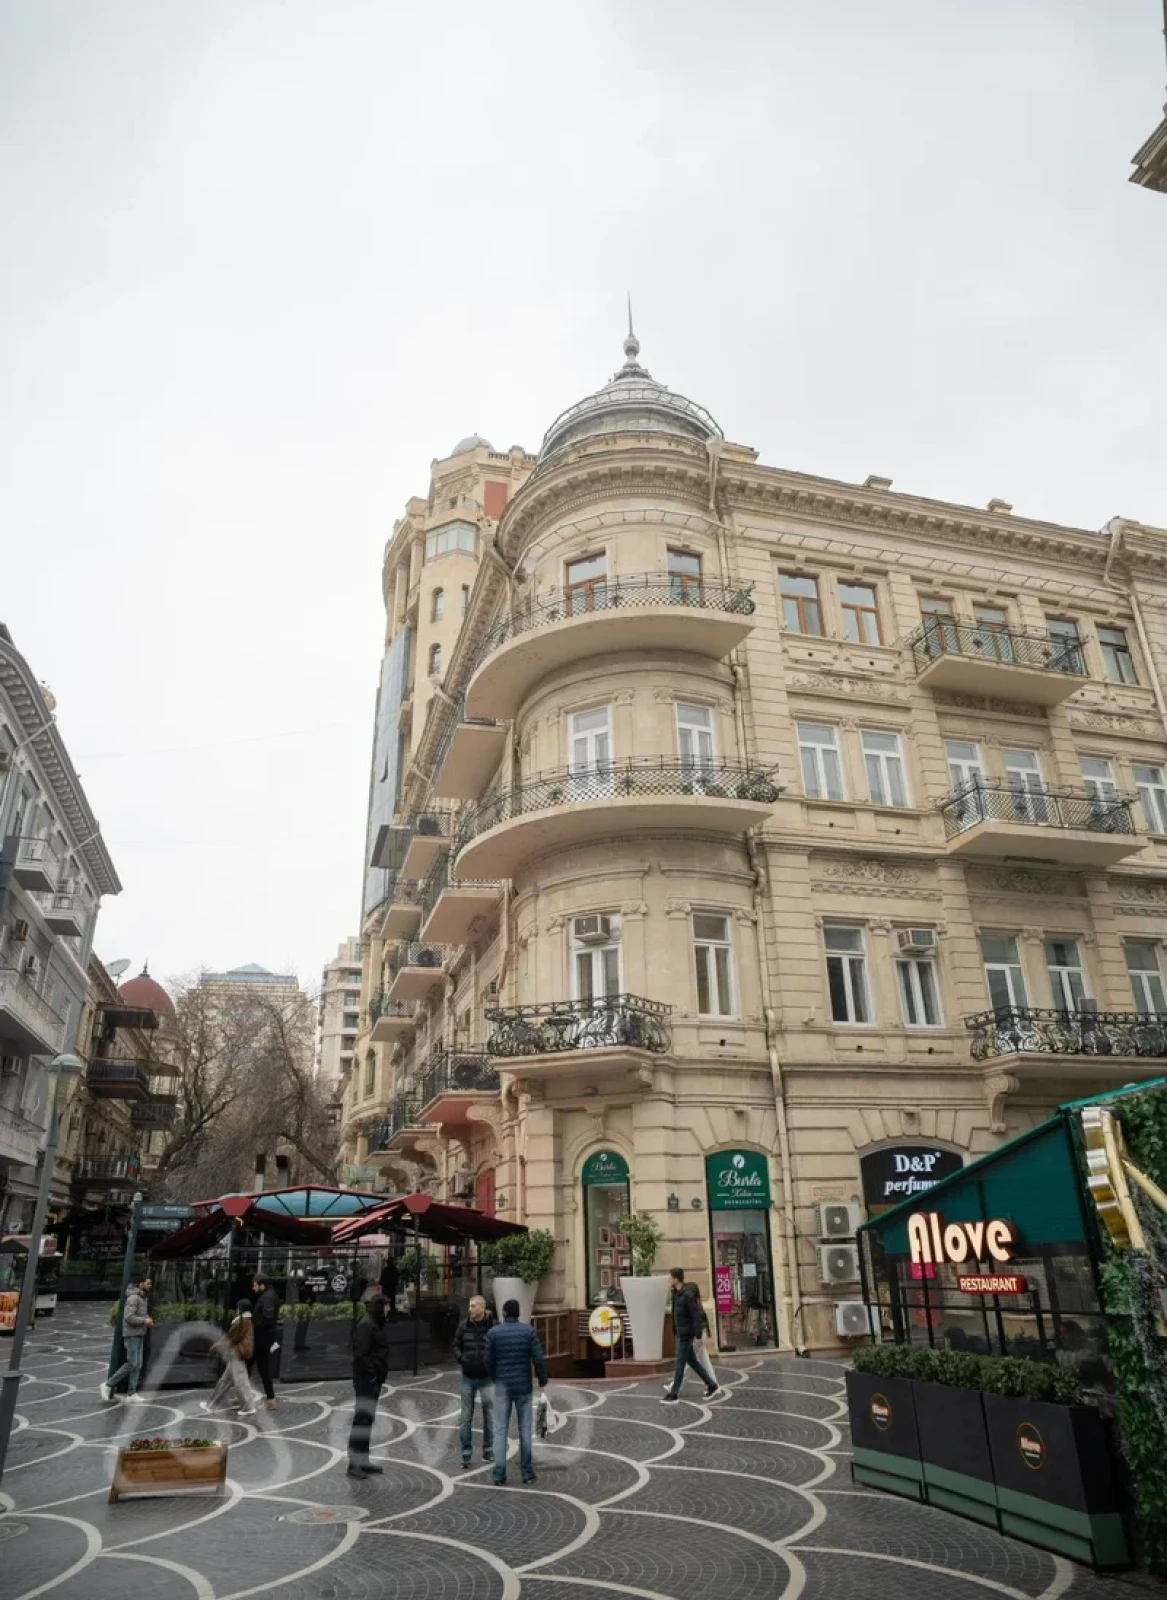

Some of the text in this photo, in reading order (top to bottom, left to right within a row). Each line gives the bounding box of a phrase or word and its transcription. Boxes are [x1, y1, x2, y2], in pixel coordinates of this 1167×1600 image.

[718, 1169, 762, 1188] Burla
[908, 1212, 1013, 1264] Alove
[959, 1277, 1018, 1292] RESTAURANT
